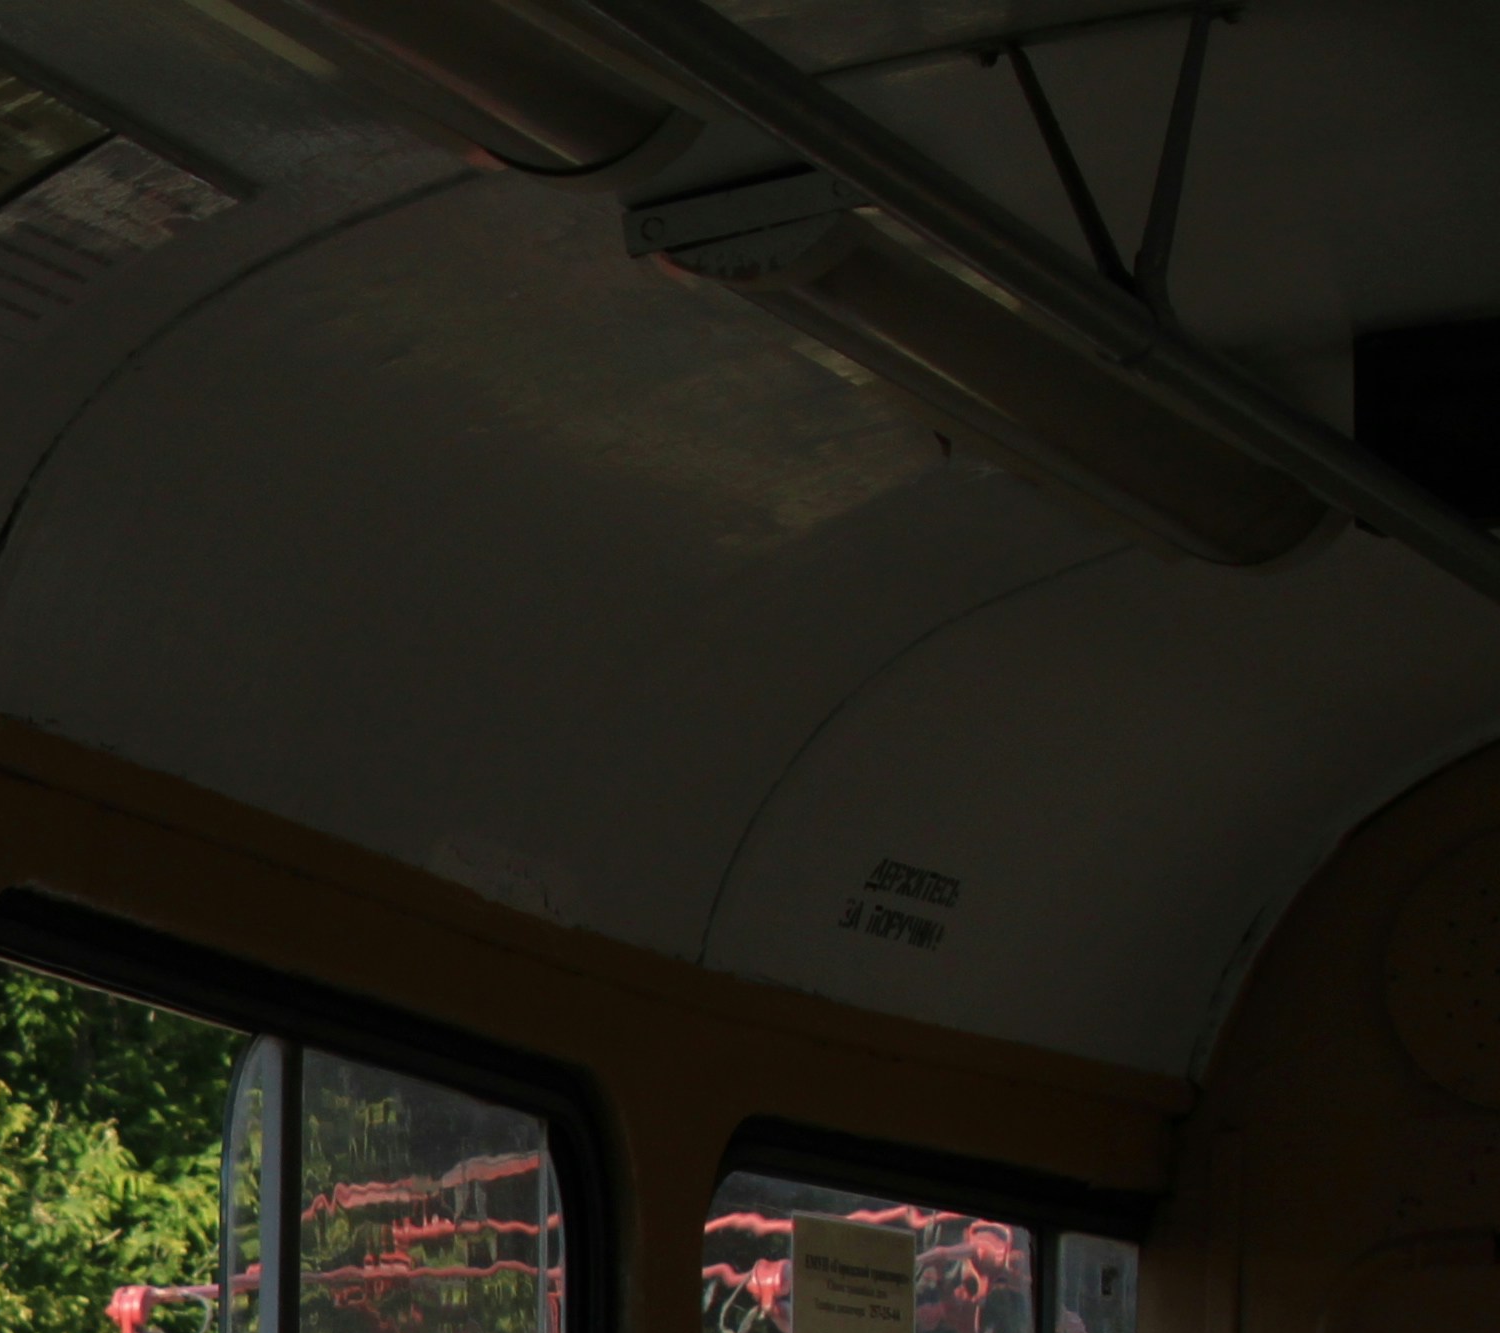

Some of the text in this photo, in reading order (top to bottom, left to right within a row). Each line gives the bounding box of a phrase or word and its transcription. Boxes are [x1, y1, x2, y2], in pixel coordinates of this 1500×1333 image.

[863, 857, 960, 908] ДЕРЖИТЕСЬ
[838, 898, 946, 951] ЗА ПОРУЧНИ!
